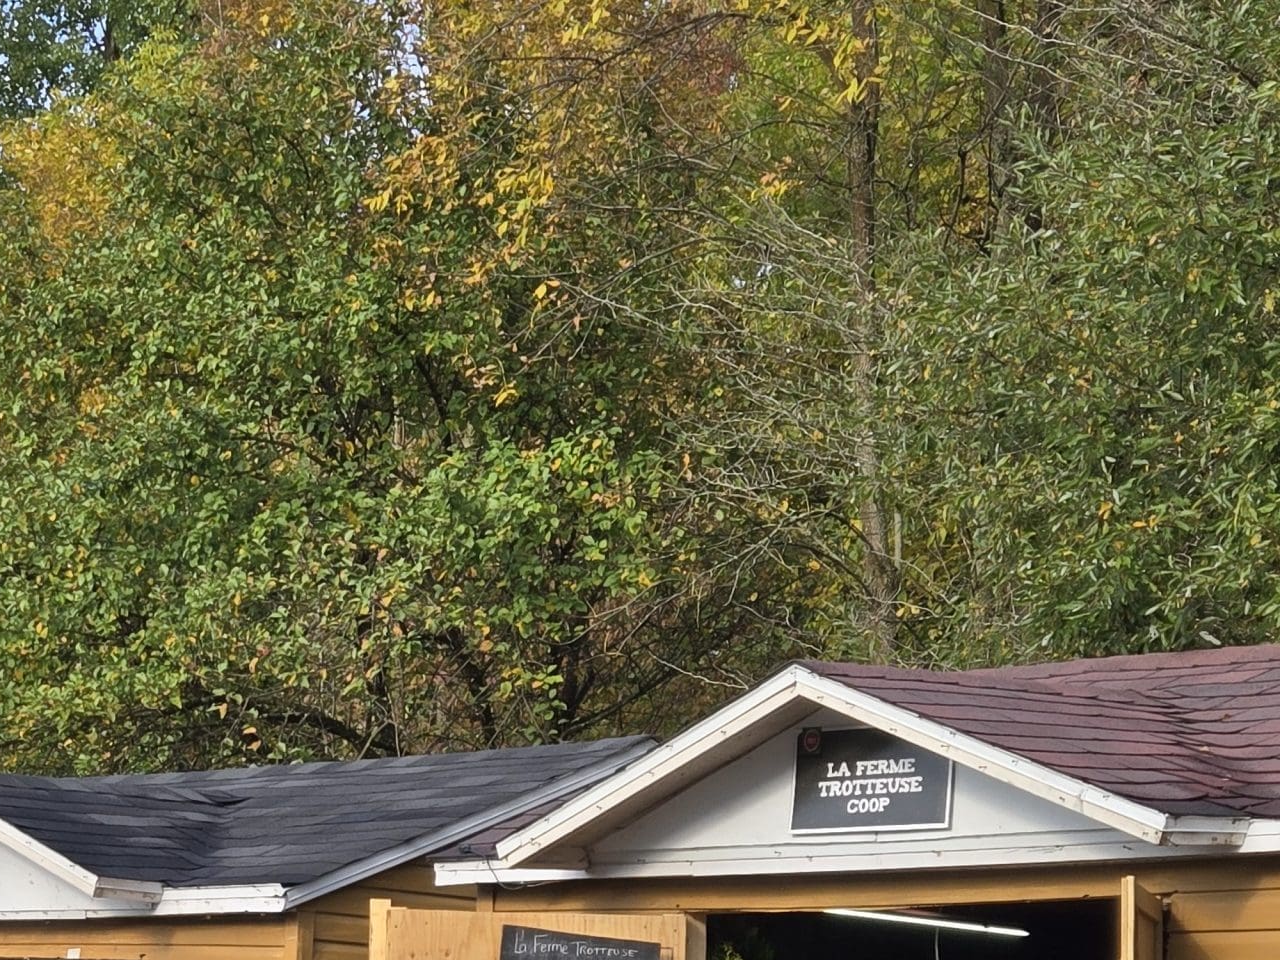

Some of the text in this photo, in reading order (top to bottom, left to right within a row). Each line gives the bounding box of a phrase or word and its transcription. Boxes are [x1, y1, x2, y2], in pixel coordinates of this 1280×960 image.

[827, 758, 916, 777] LA FERME
[818, 776, 923, 797] TROTTEUSE
[847, 797, 890, 813] COOP
[533, 934, 569, 955] Ferme
[570, 941, 639, 957] TROTTEUSE
